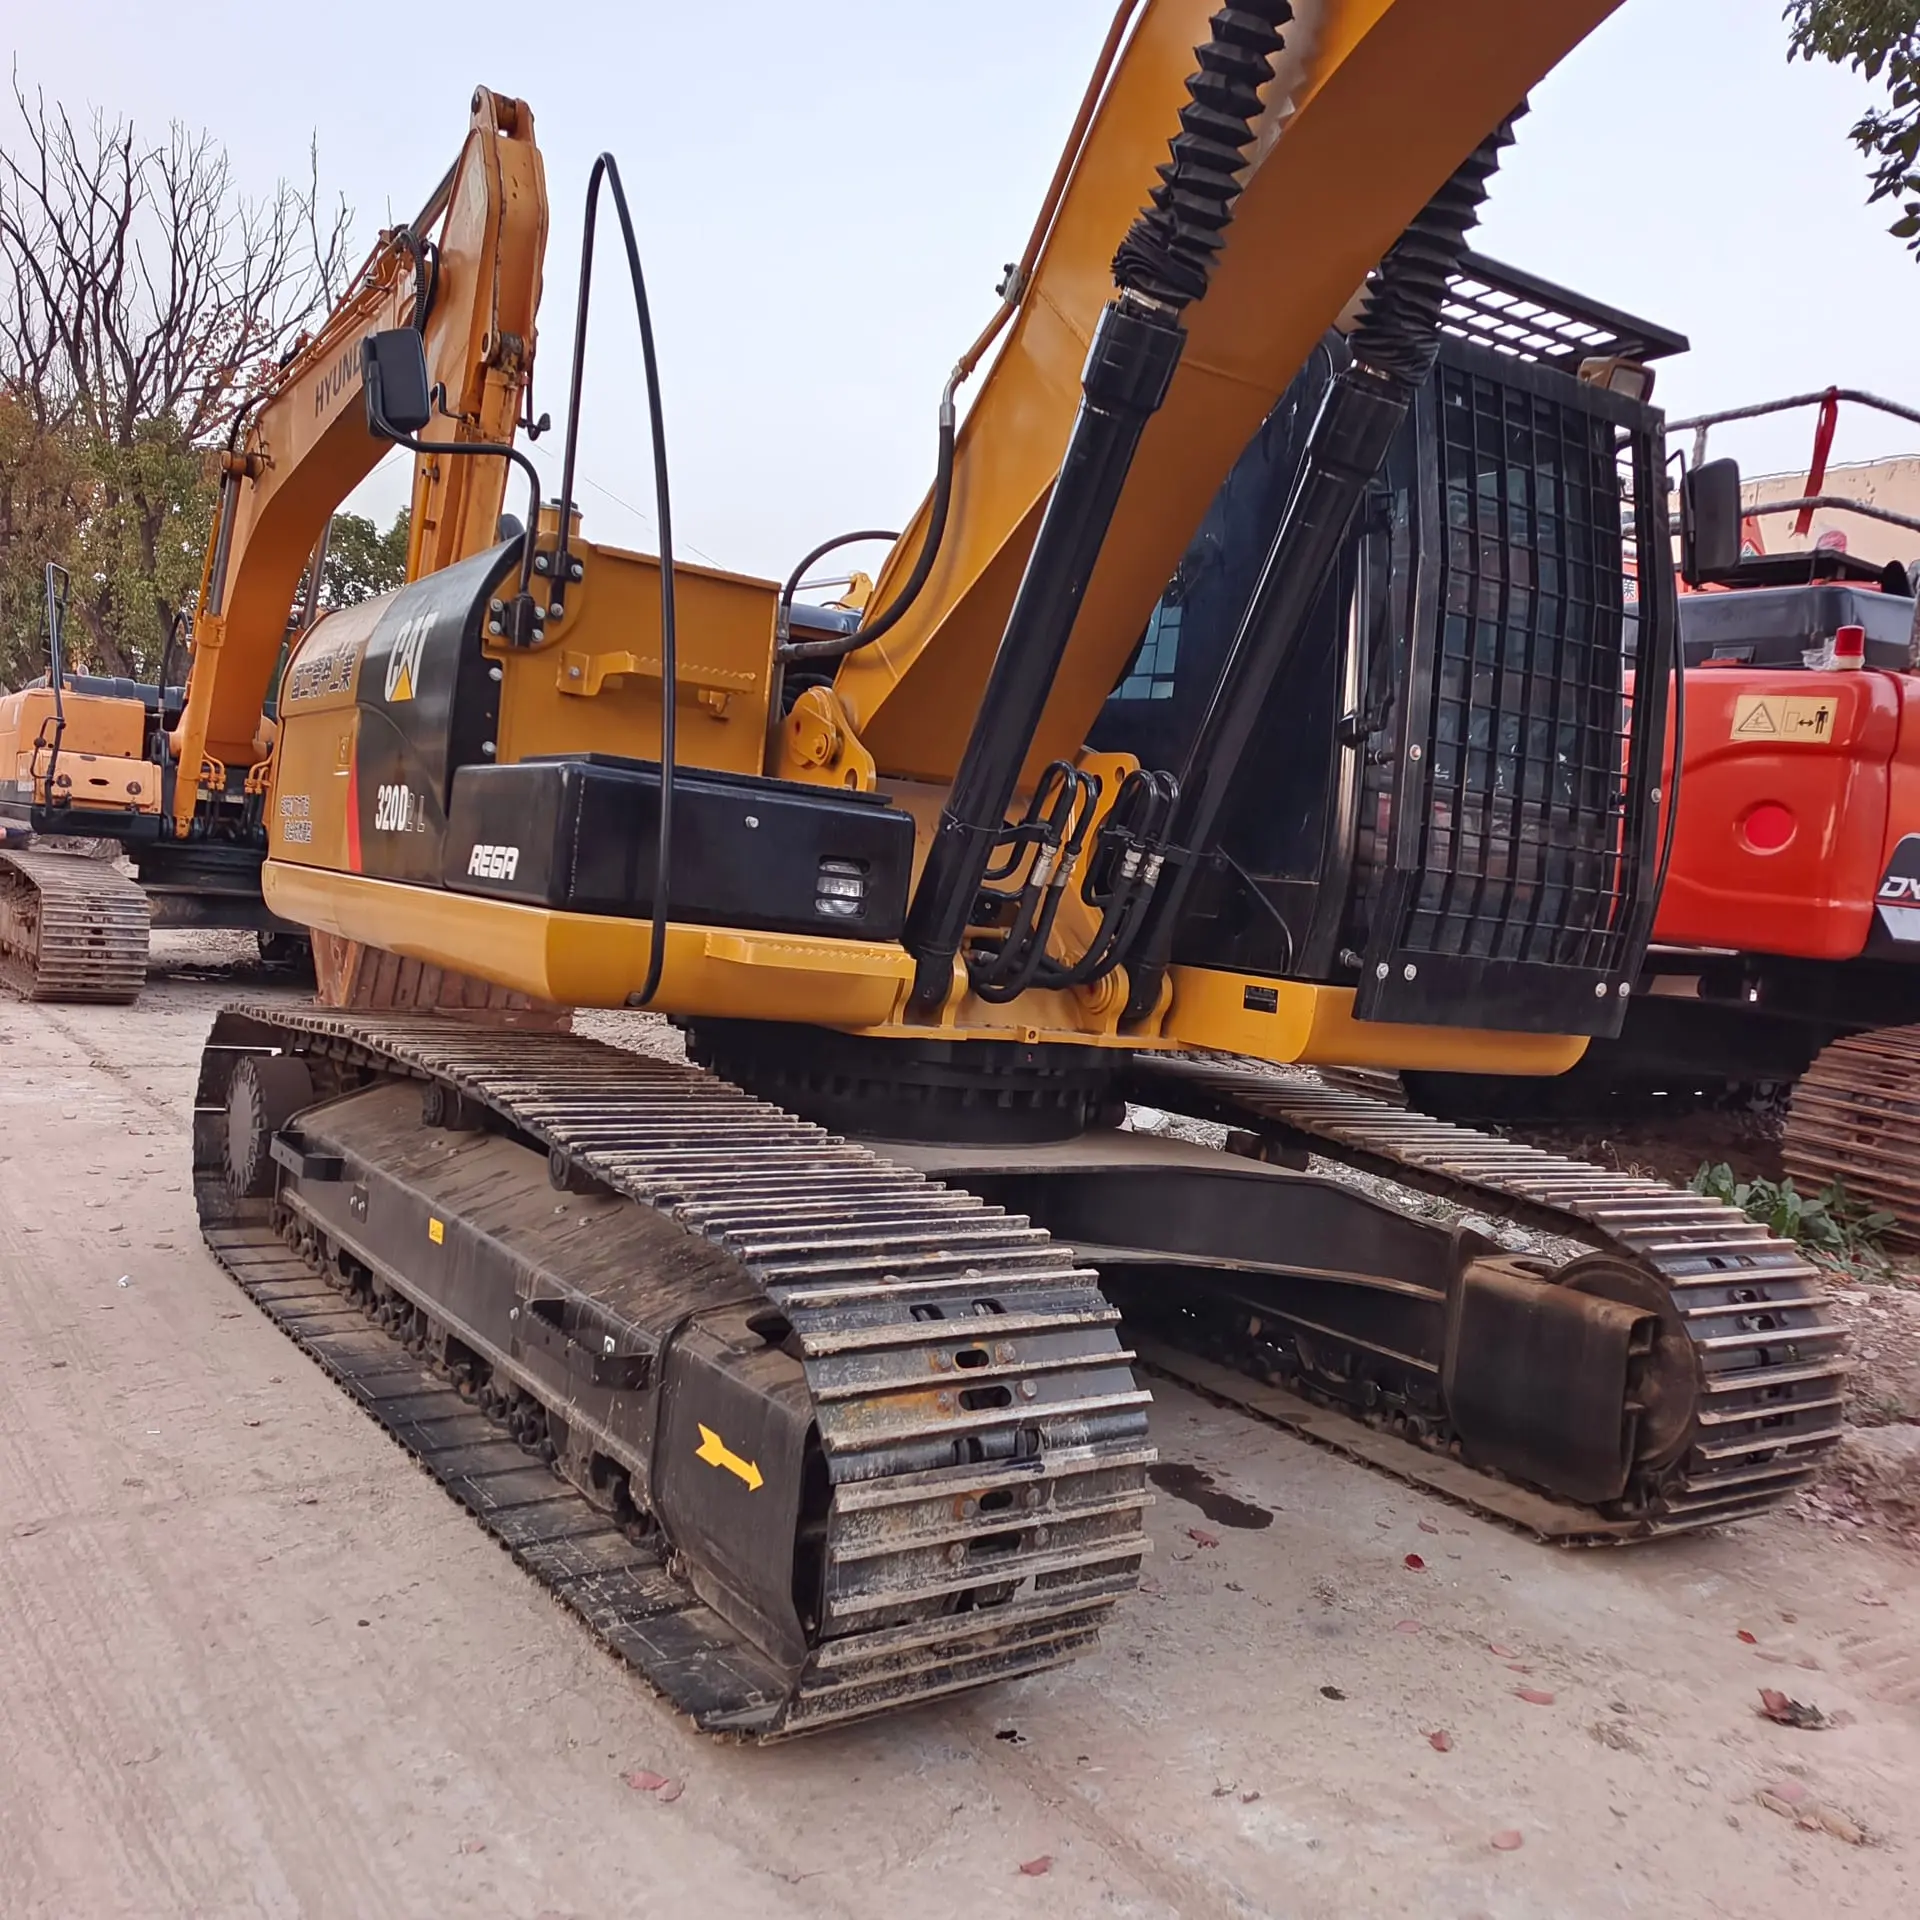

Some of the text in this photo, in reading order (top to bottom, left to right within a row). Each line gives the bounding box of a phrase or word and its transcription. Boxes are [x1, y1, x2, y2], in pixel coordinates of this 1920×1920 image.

[315, 338, 362, 418] HYUND
[384, 611, 439, 703] CAT
[467, 844, 519, 880] REGA
